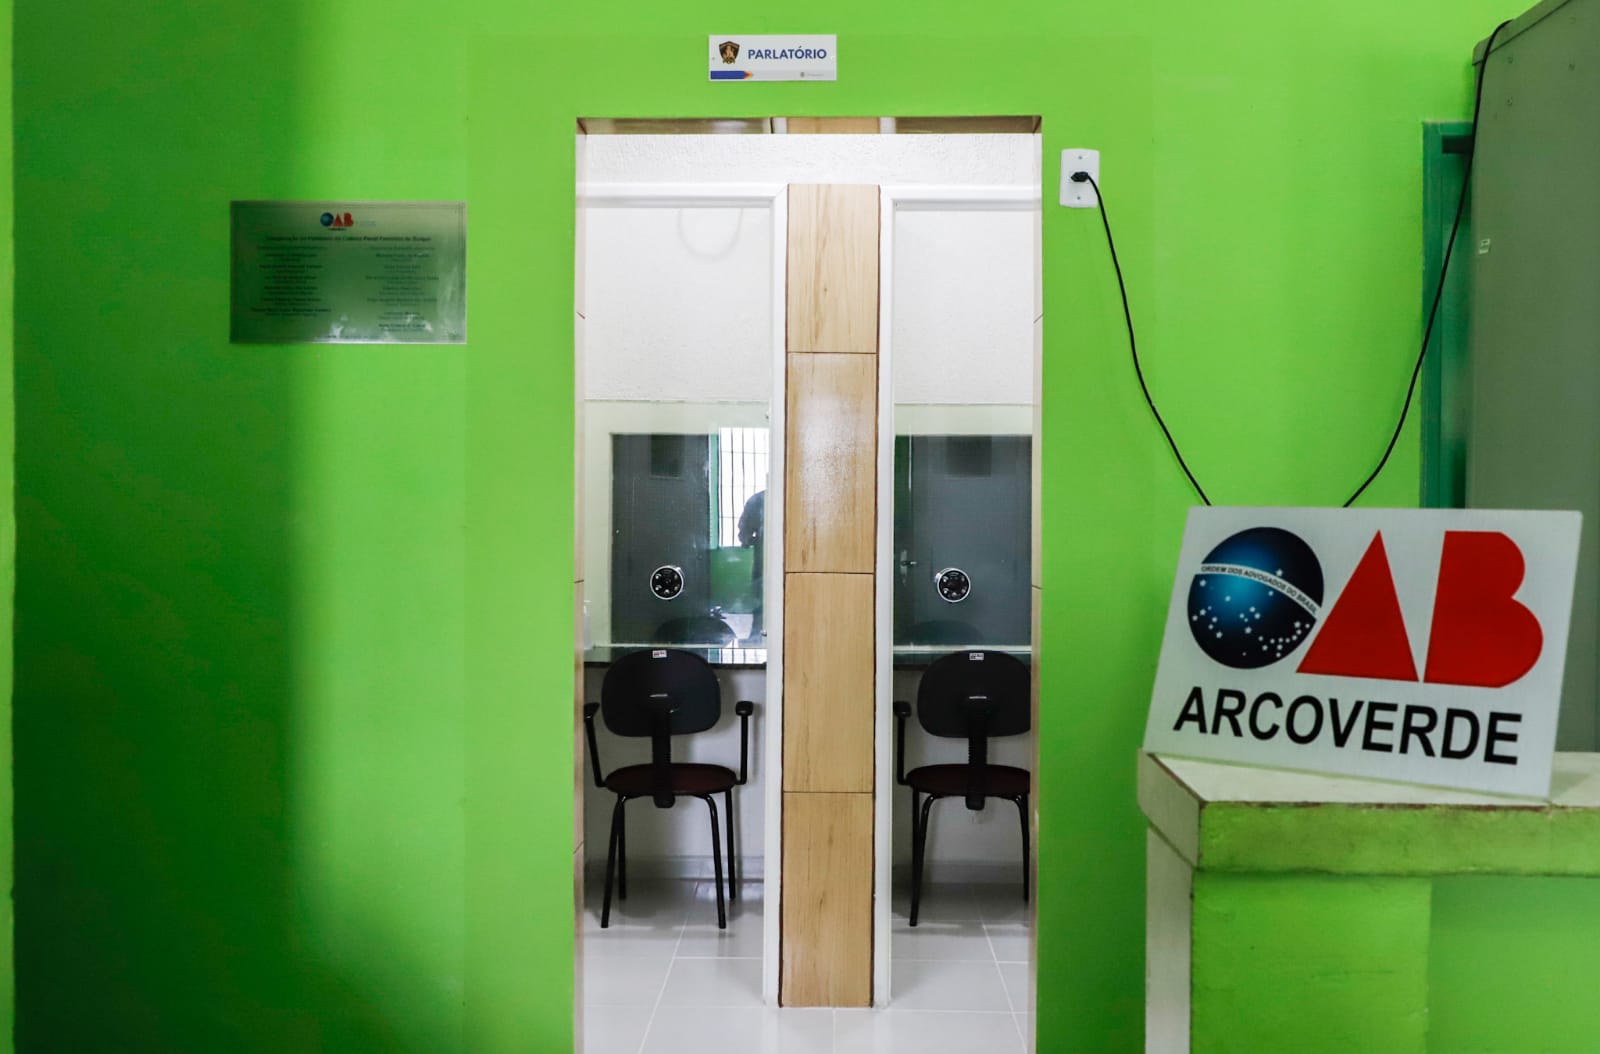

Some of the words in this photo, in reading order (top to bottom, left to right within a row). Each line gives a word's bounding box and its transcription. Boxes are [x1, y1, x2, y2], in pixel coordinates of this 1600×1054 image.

[748, 45, 827, 59] PARLATÓRIO
[1187, 526, 1544, 689] OAB
[1201, 565, 1228, 573] ORDEM
[1228, 567, 1243, 575] DOS
[1244, 569, 1287, 591] ADVOGADOS
[1286, 586, 1297, 597] DO
[1296, 594, 1318, 614] BRASIL
[1173, 686, 1523, 766] ARCOVERDE
